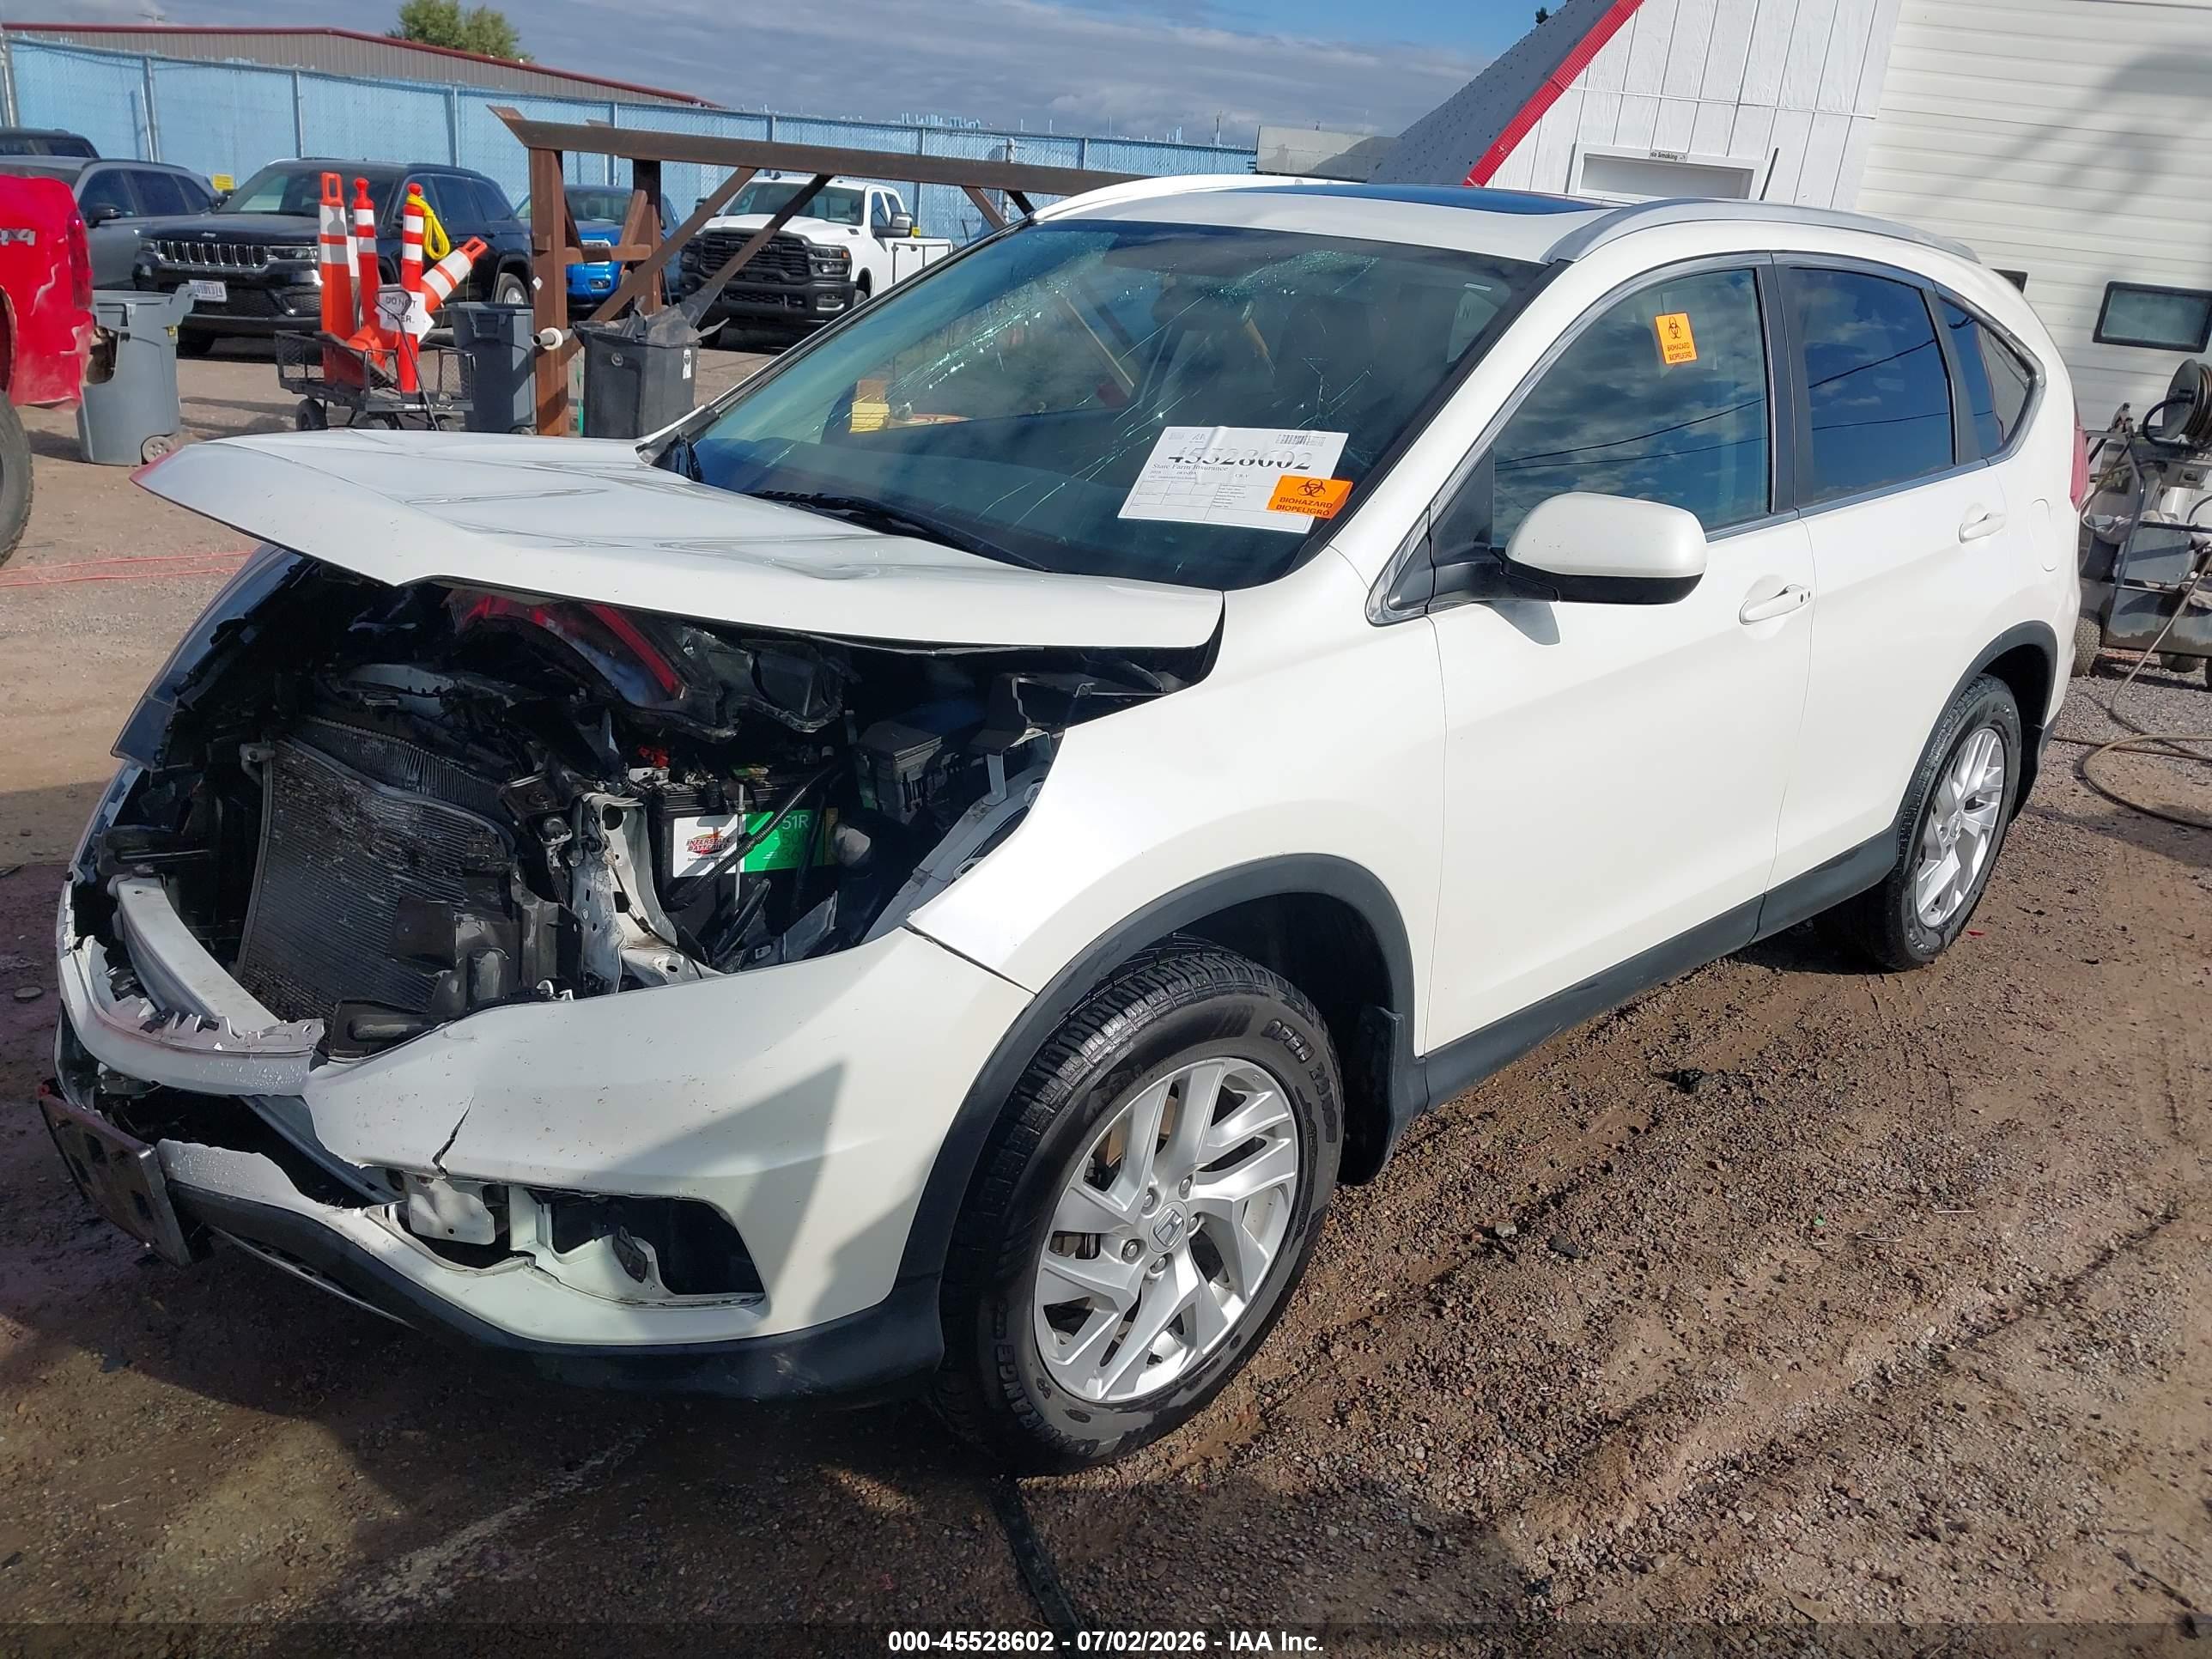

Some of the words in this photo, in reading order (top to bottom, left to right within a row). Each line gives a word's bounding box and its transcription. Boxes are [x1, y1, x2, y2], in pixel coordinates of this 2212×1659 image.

[386, 296, 398, 306] DO
[398, 298, 418, 309] NT
[1192, 464, 1229, 472] Insurance
[1279, 497, 1334, 508] BIOHAZARD
[1276, 504, 1330, 516] BIOPELIGRO
[782, 814, 809, 830] 51R
[687, 843, 728, 852] BATTERIES
[1261, 1018, 1316, 1064] OPEN
